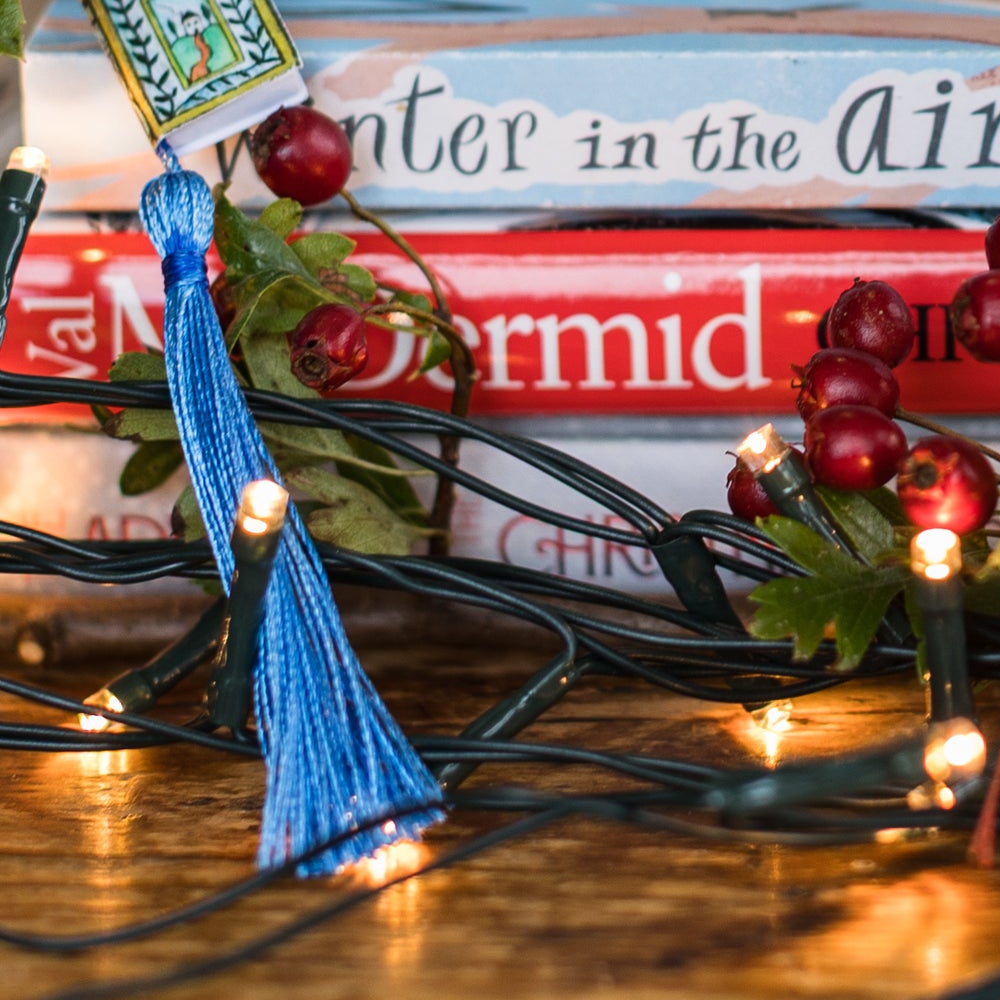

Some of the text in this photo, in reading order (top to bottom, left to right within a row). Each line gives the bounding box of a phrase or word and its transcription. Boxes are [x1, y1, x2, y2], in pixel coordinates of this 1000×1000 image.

[215, 73, 537, 185] nter
[574, 119, 657, 171] in
[682, 113, 800, 172] the
[21, 292, 98, 379] Val
